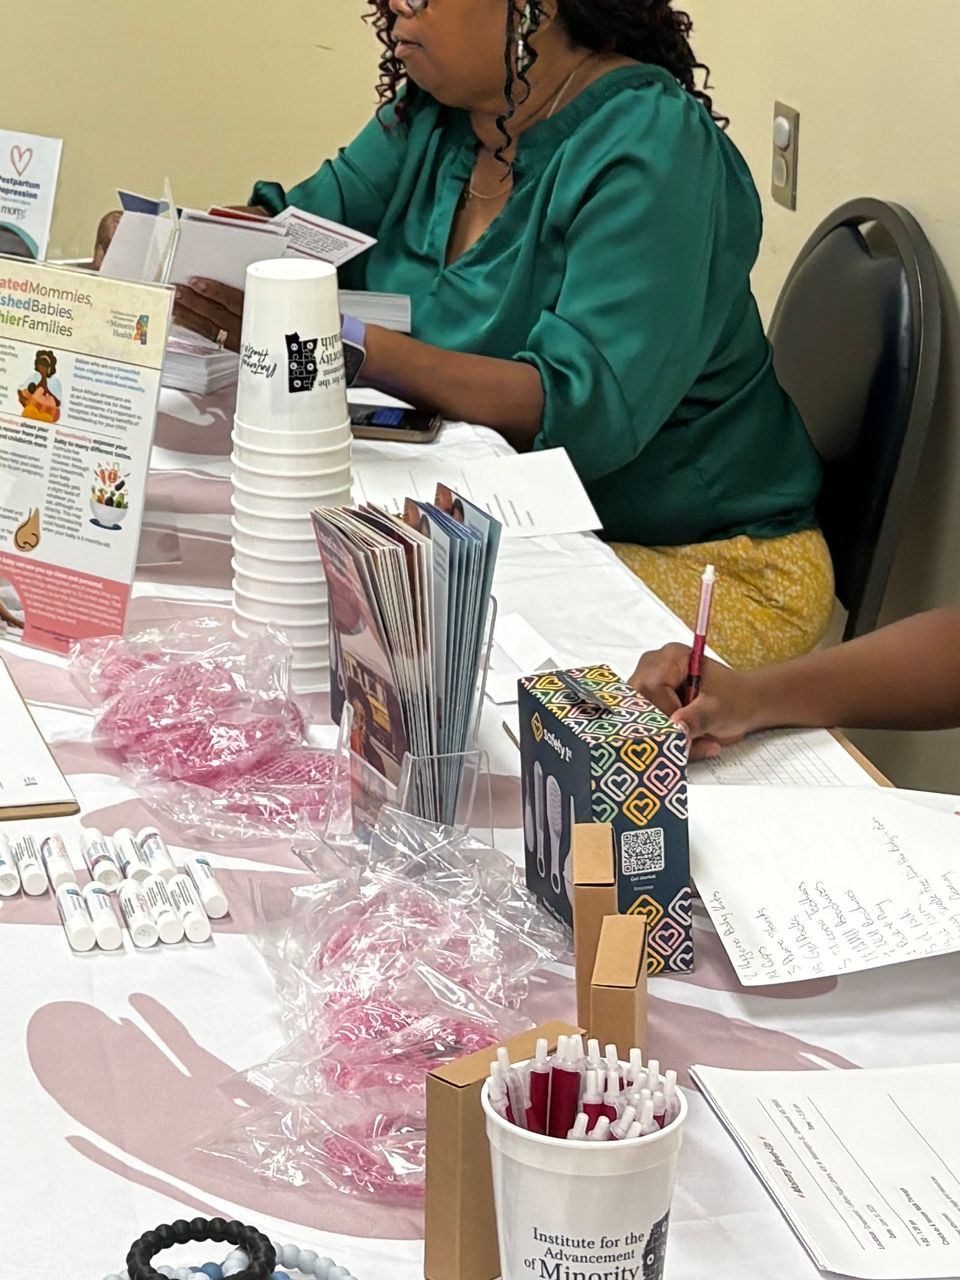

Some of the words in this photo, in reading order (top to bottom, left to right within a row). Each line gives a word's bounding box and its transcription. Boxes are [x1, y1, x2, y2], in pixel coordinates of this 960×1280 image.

[320, 333, 342, 351] alth
[318, 350, 344, 365] ority
[532, 1226, 596, 1249] Institute
[600, 1236, 620, 1250] for
[625, 1230, 645, 1246] the
[544, 1247, 636, 1264] Advancement
[524, 1256, 539, 1270] of
[539, 1257, 641, 1280] Minority
